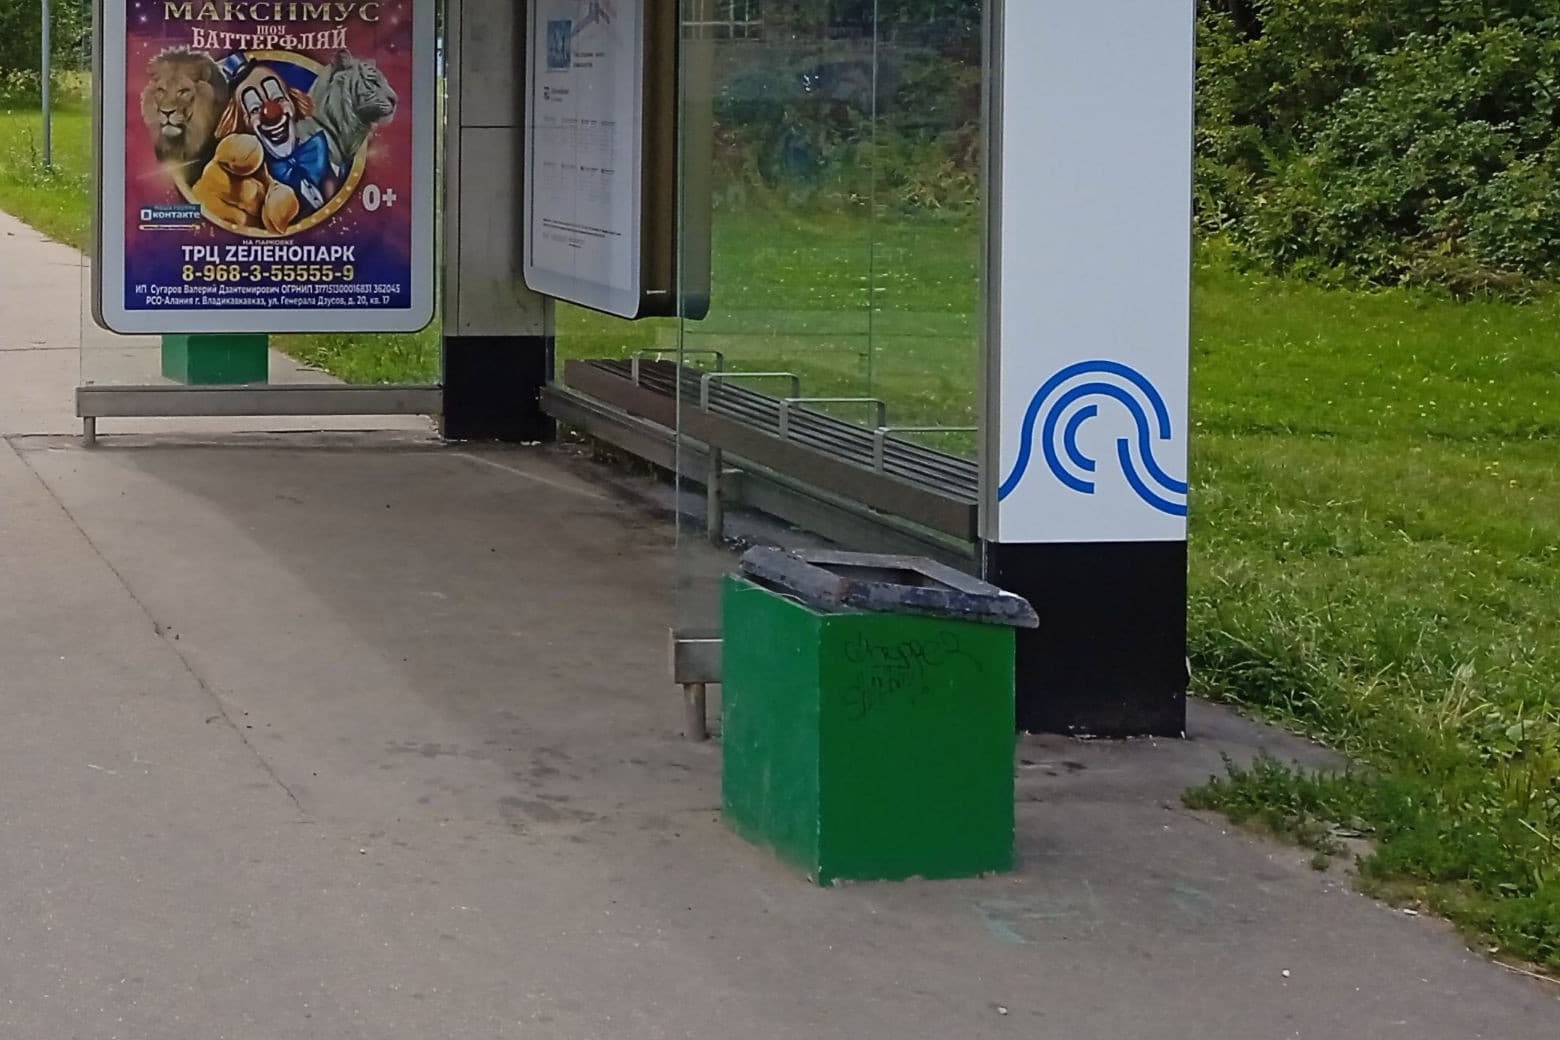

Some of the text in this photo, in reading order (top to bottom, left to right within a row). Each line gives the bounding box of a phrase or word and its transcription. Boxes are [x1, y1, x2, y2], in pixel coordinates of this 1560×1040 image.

[164, 1, 380, 21] МАКСИМУС
[192, 25, 348, 50] БАТТЕРФЛЯЙ
[363, 184, 397, 211] 0+
[182, 246, 355, 264] ТРЦ ZЕЛЕНОПАРК
[182, 265, 354, 281] 8-968-3-55555-9
[135, 284, 147, 293] ИП
[151, 284, 182, 295] Сугаров
[184, 284, 217, 295] Валерий
[281, 284, 313, 294] ОГРНИП
[146, 296, 193, 305] РСО-Алания
[281, 296, 316, 306] Генерала
